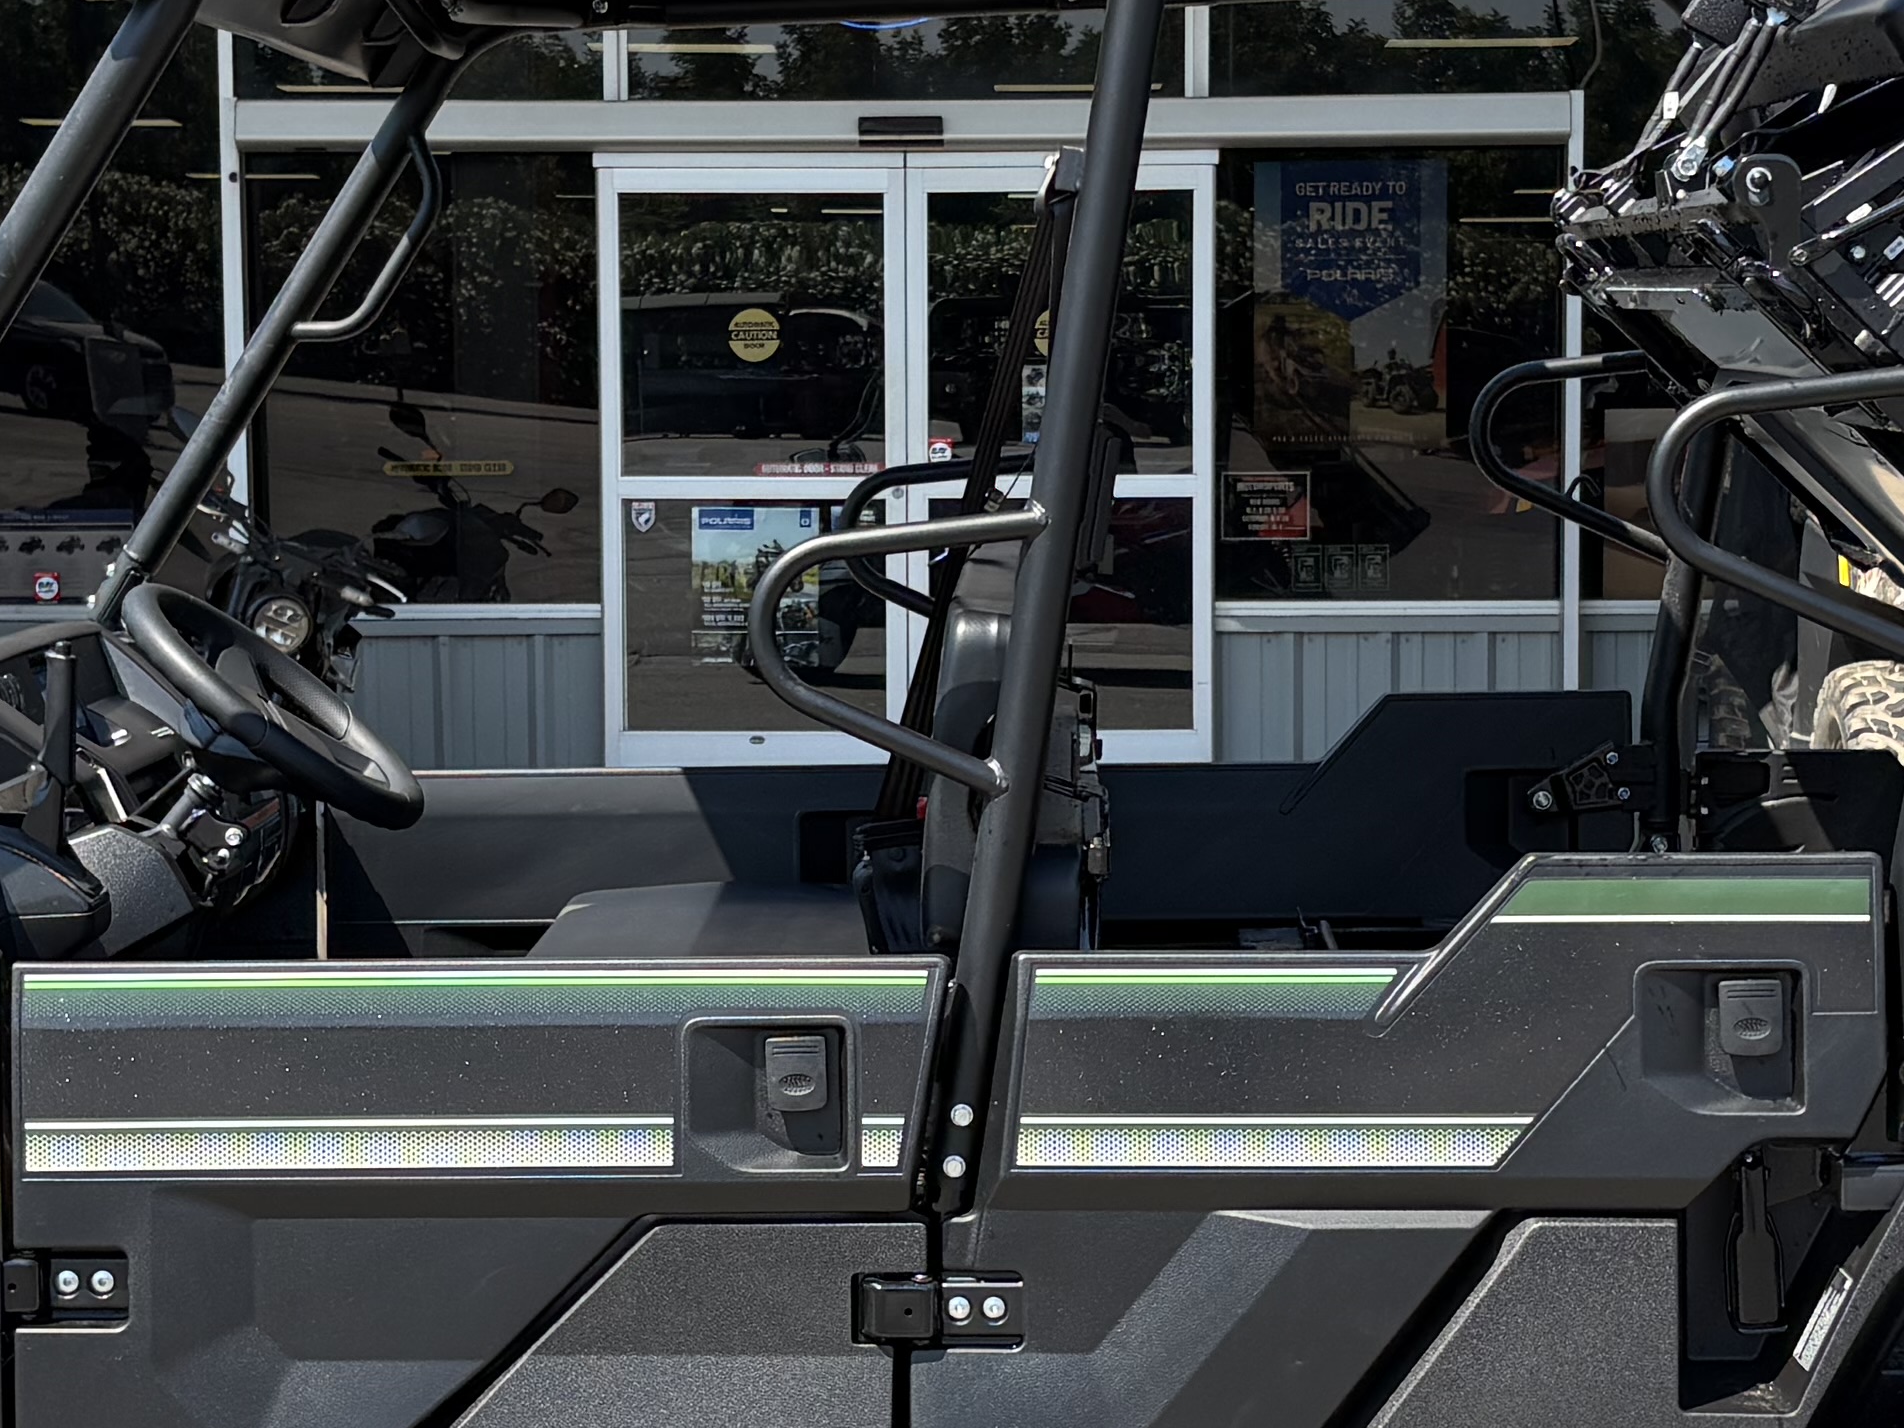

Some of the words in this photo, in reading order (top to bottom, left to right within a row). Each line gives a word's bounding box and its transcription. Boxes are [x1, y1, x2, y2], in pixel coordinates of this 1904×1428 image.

[1296, 183, 1327, 196] GET
[1330, 181, 1383, 196] READY
[1387, 180, 1407, 195] TO
[1308, 201, 1394, 233] RIDE
[1296, 238, 1348, 249] SALES
[1307, 268, 1396, 281] POLARIS
[731, 331, 778, 340] CAUTION
